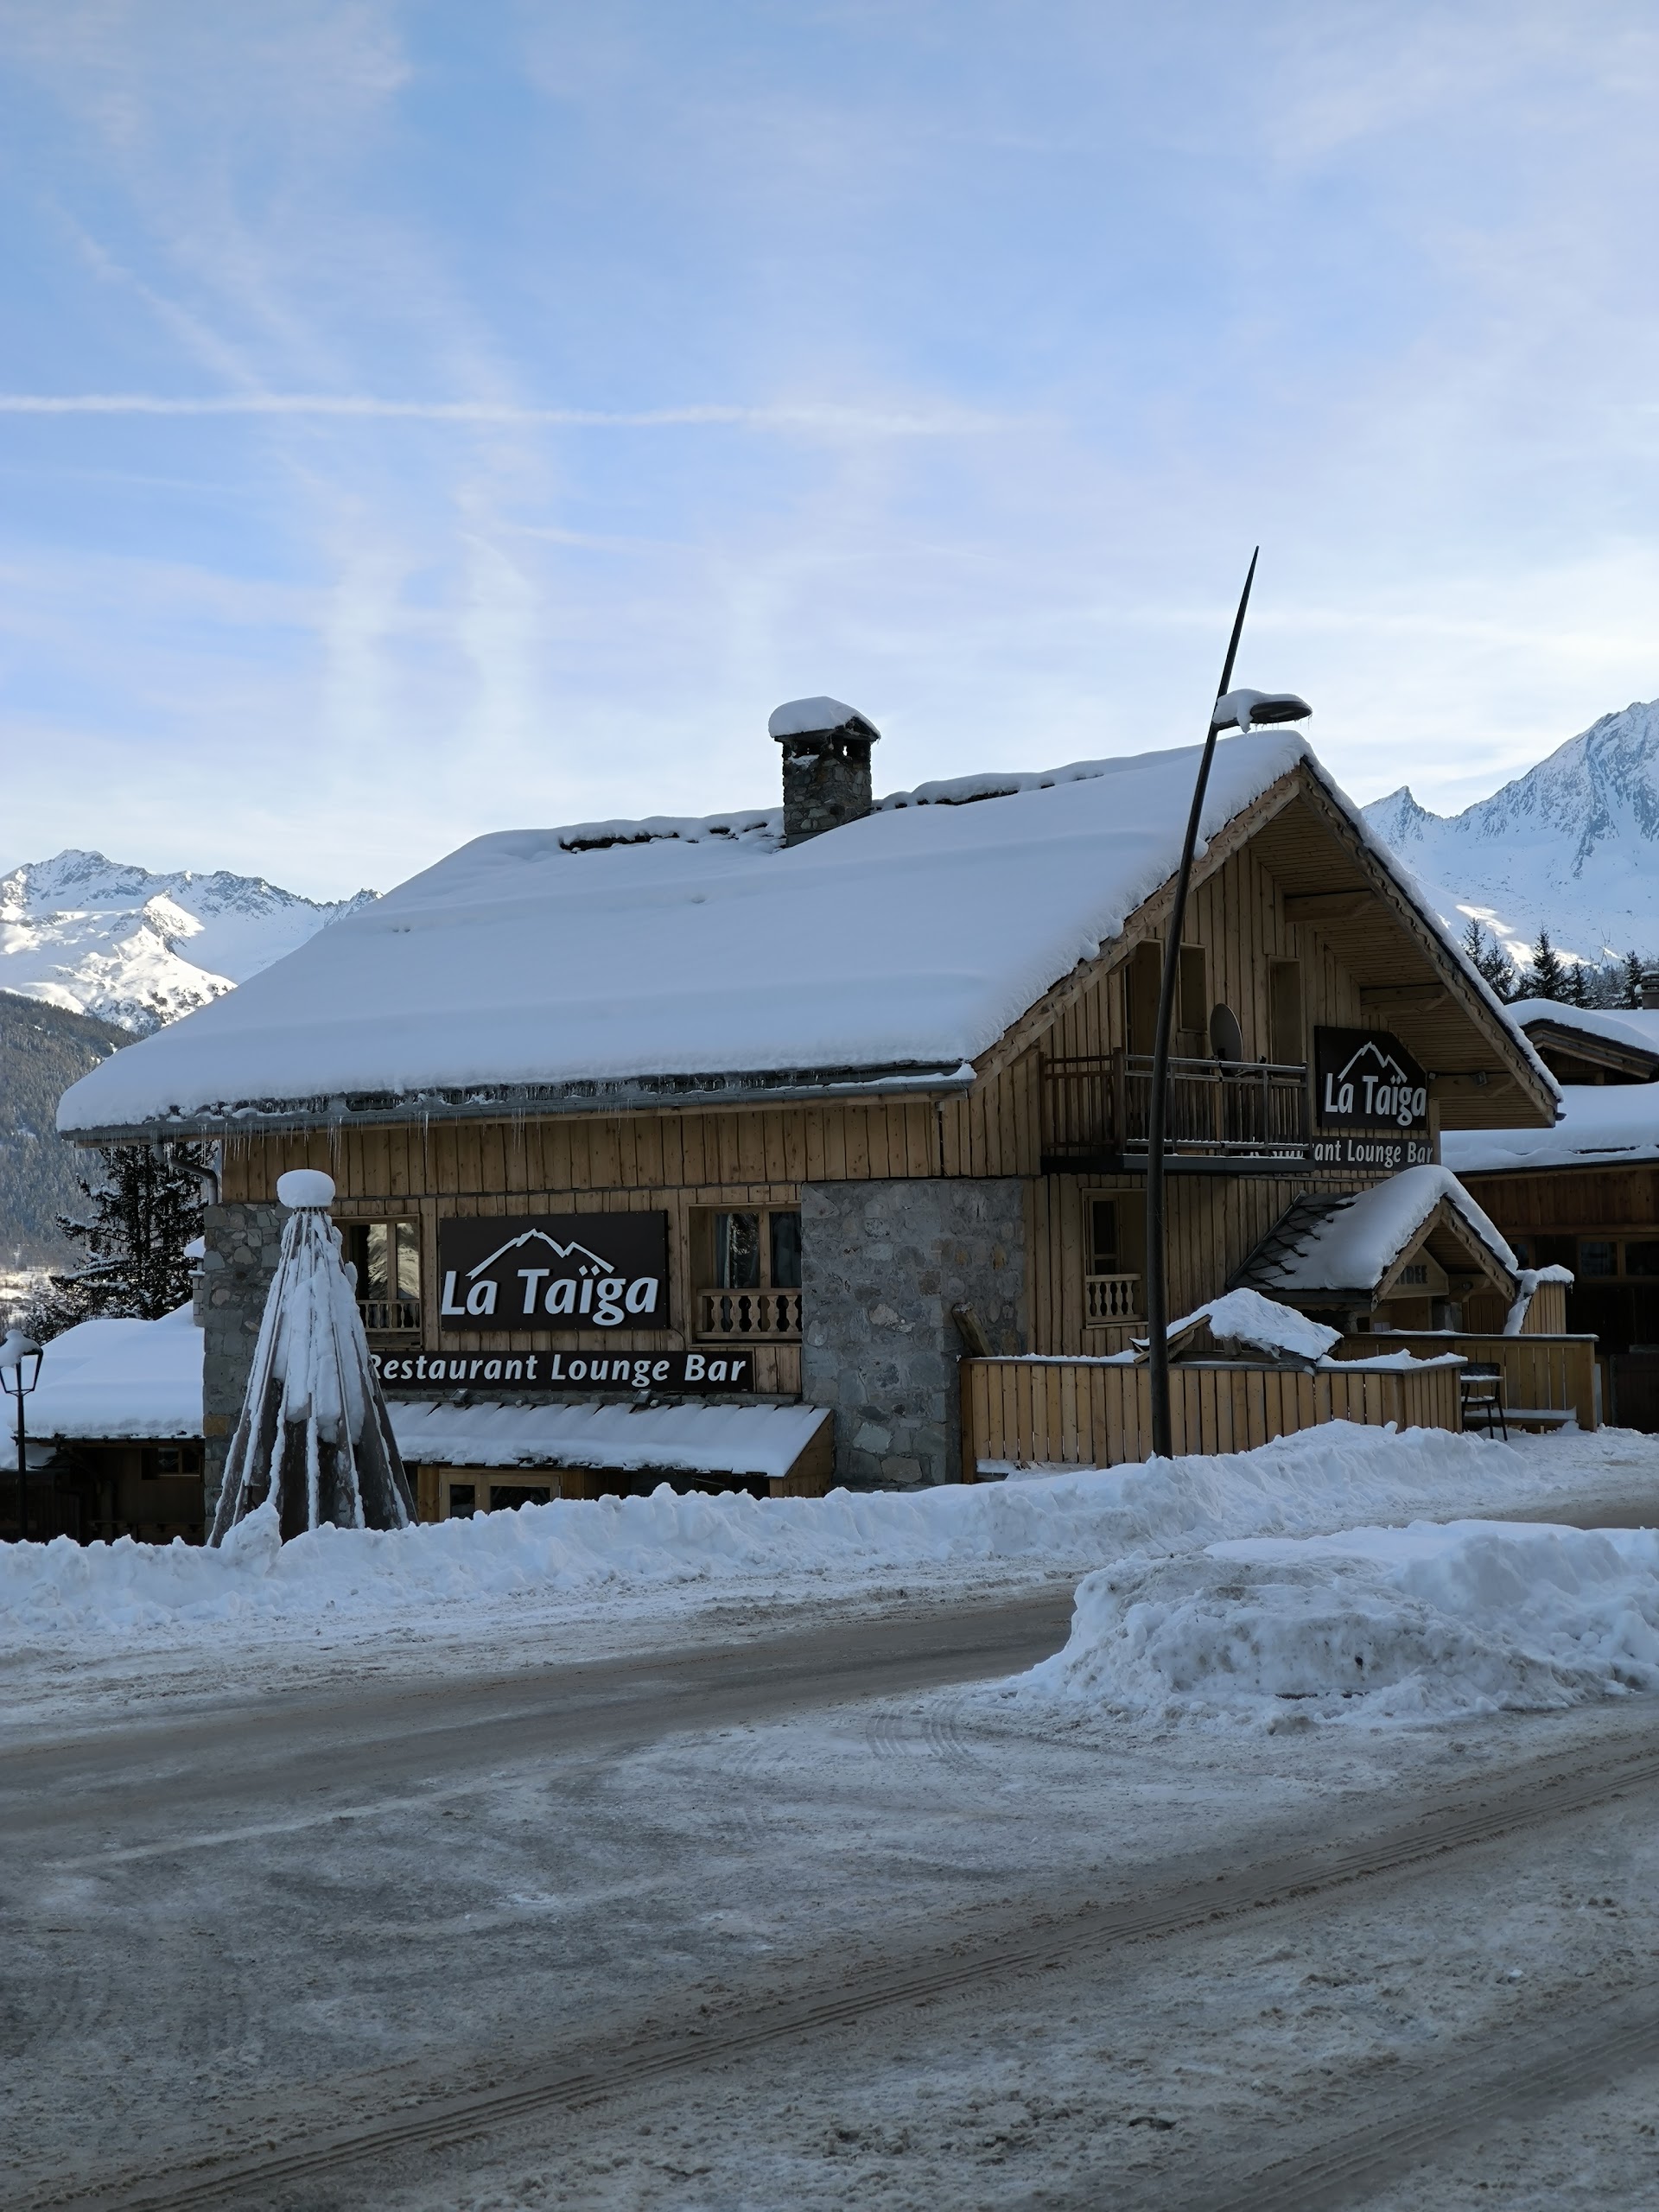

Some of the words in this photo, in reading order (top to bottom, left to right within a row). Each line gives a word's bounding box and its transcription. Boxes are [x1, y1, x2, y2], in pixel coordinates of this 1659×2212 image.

[1325, 1072, 1354, 1114] La
[1362, 1074, 1427, 1127] Taïga
[1347, 1139, 1402, 1168] Lounge
[1408, 1141, 1433, 1164] Bar
[441, 1269, 499, 1316] La
[517, 1265, 659, 1326] Taïga
[371, 1353, 538, 1381] Restaurant
[551, 1353, 671, 1388] Lounge
[684, 1354, 747, 1382] Bar
